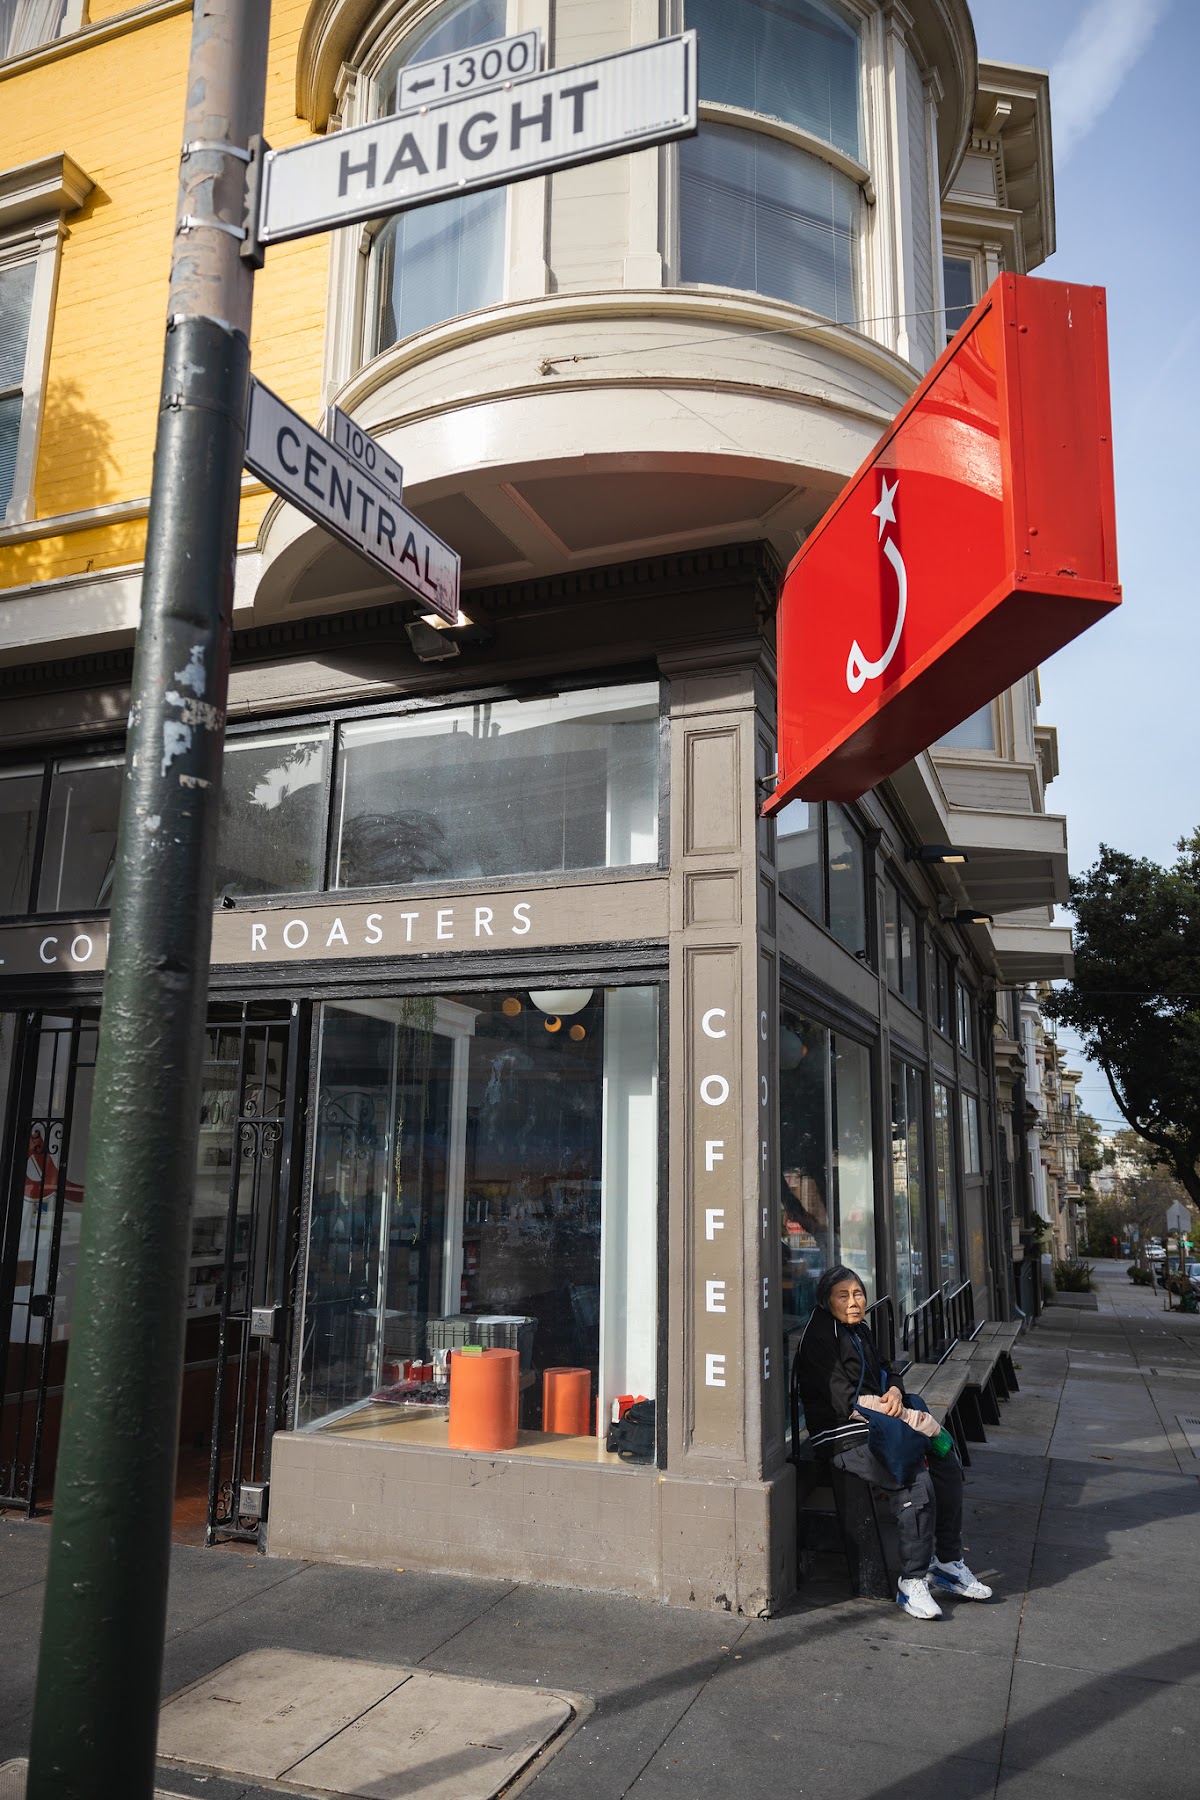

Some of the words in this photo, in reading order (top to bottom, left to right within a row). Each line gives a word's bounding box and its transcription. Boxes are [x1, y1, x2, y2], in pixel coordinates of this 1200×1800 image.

[443, 41, 530, 94] 1300
[337, 79, 600, 197] HAIGHT
[345, 422, 377, 471] 100
[276, 425, 439, 592] CENTRAL
[250, 902, 533, 952] ROASTERS
[699, 1007, 730, 1387] COFFEE
